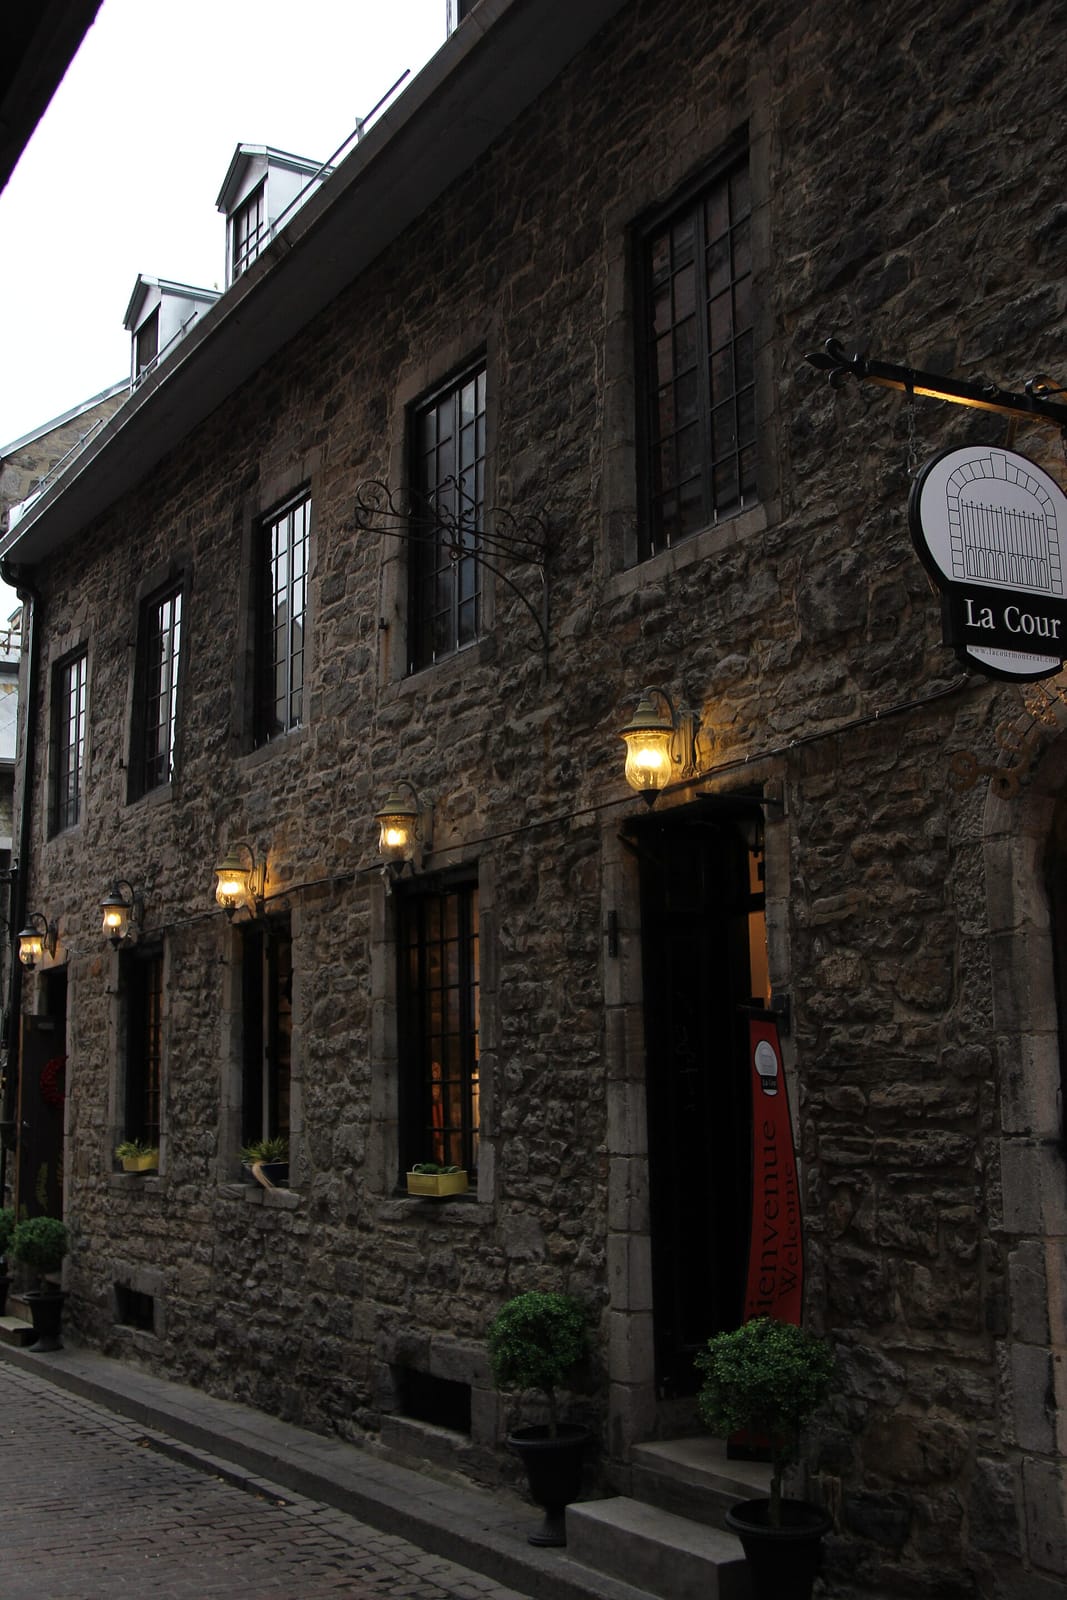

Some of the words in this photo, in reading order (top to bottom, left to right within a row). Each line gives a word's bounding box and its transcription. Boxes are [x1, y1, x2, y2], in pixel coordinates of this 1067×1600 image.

[963, 598, 995, 629] La
[1004, 606, 1062, 639] Cour
[778, 1162, 799, 1298] Welcome
